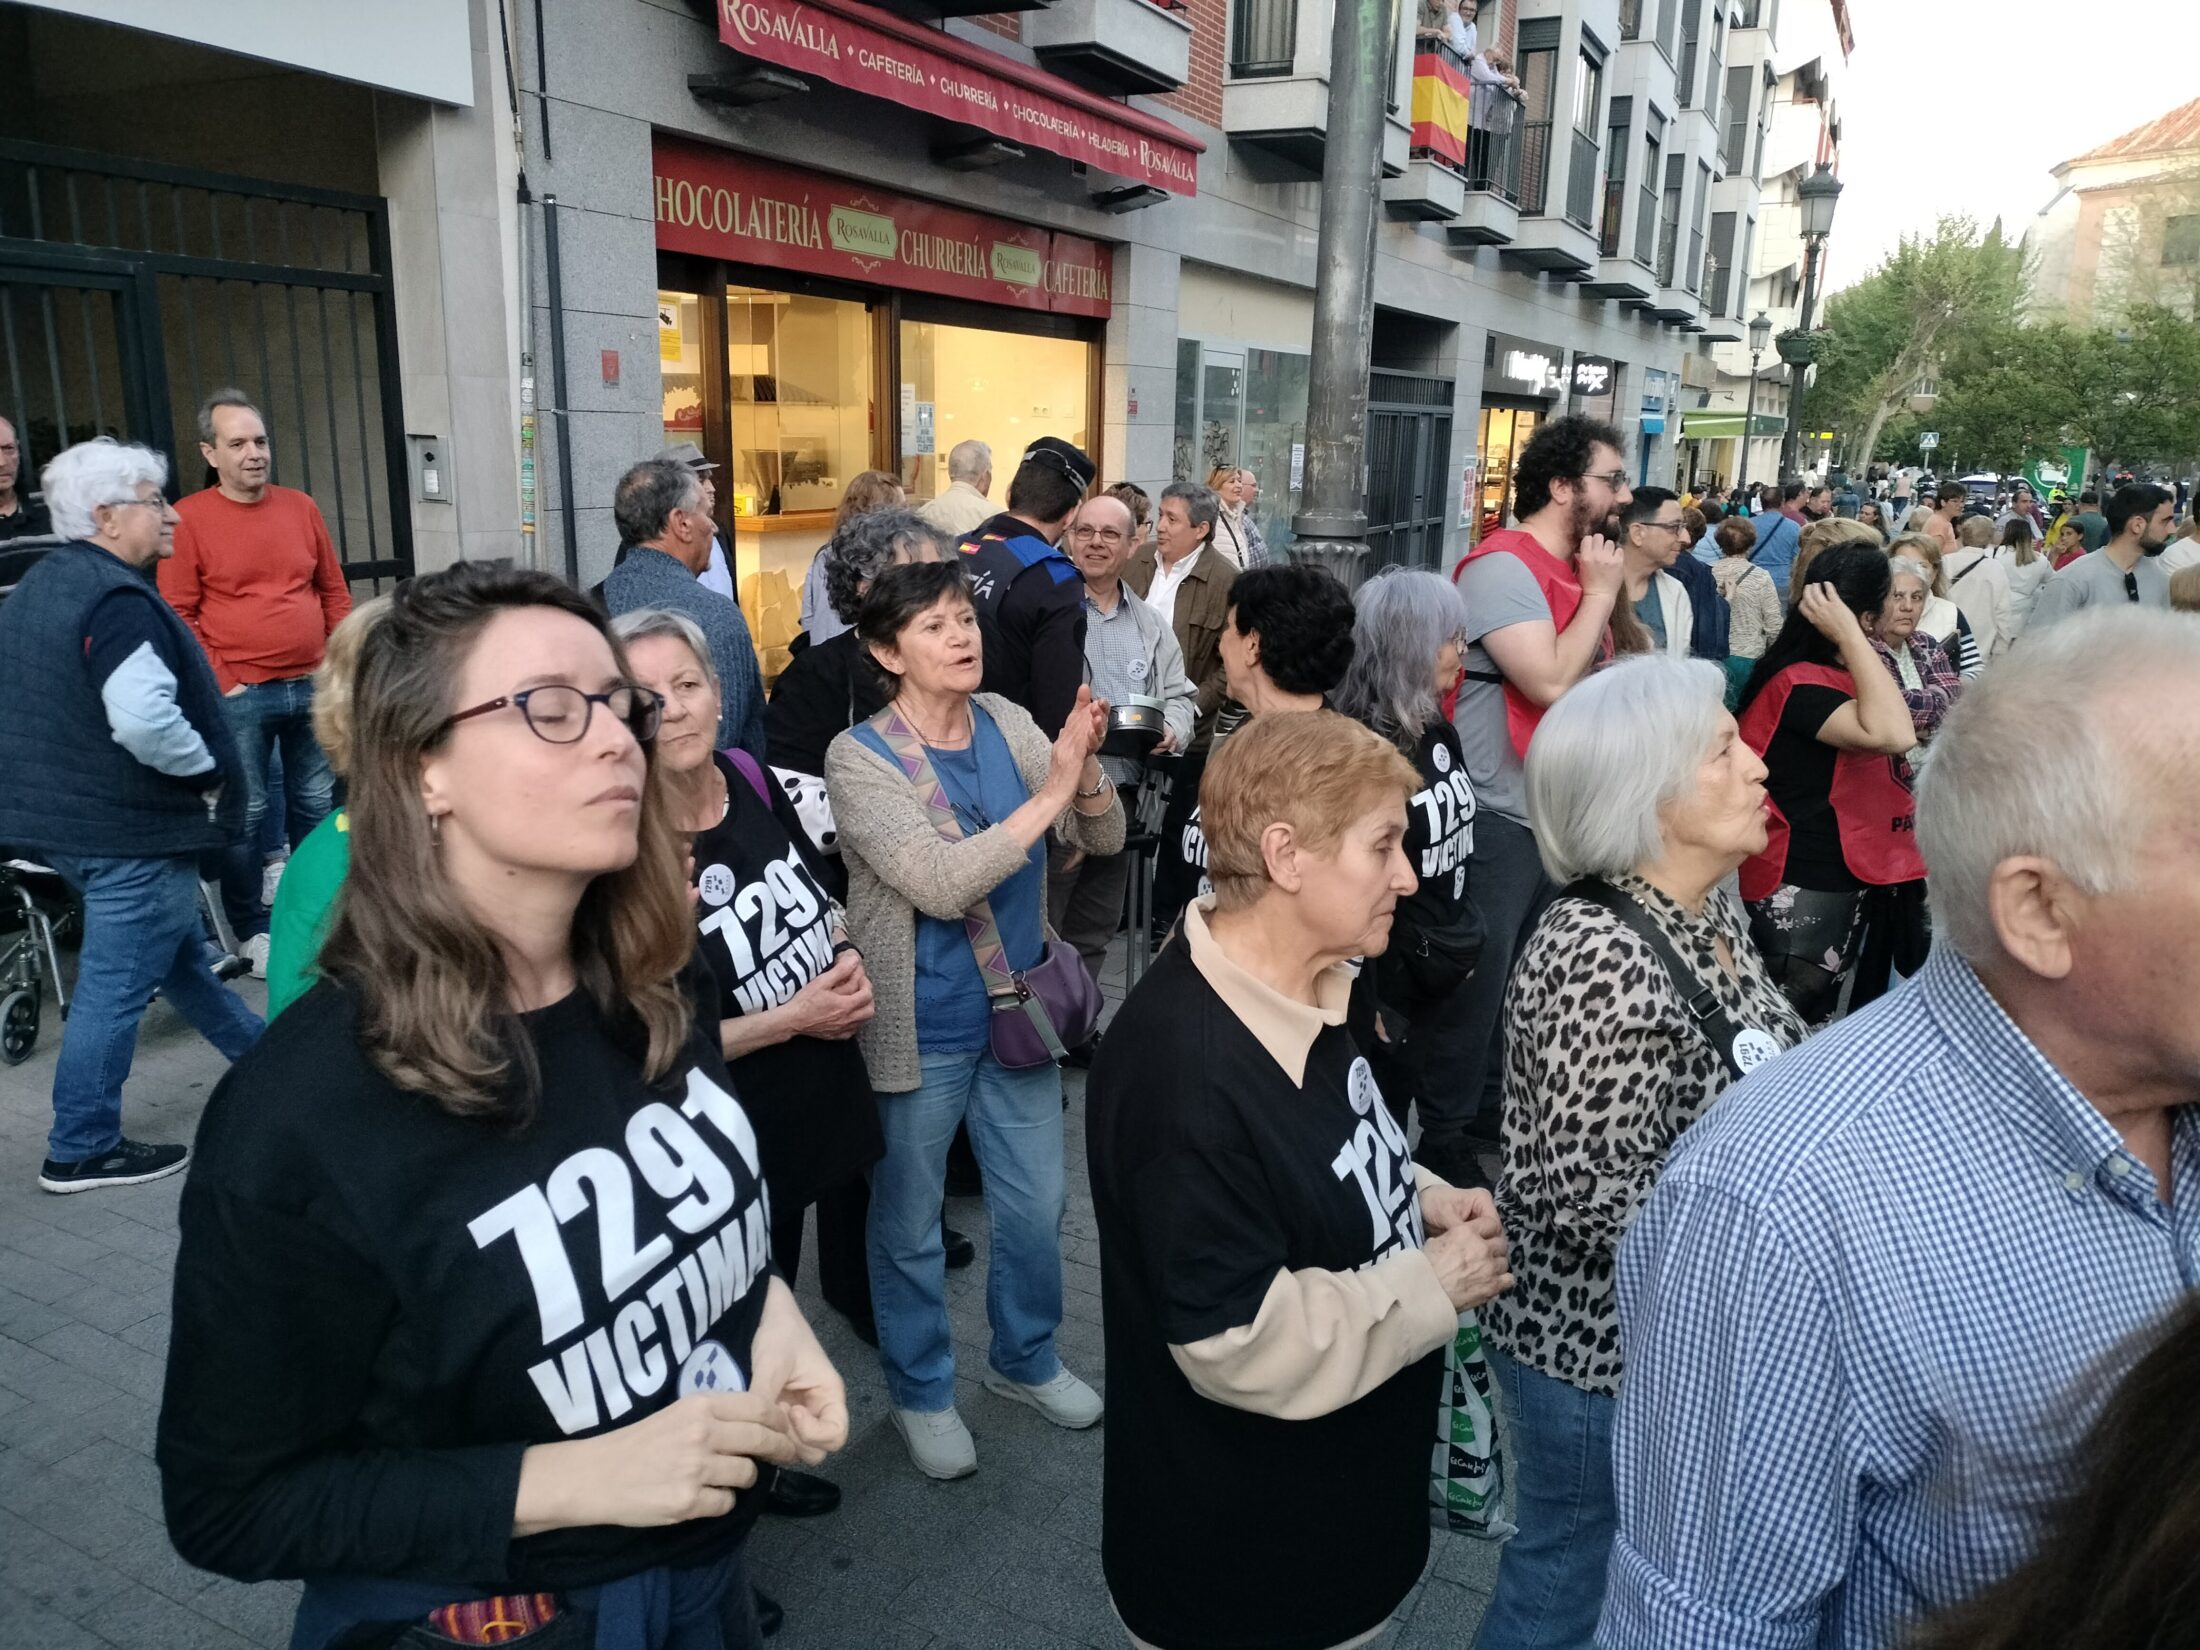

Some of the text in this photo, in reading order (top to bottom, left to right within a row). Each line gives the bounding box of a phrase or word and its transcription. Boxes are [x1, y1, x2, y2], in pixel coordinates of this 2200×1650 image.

[858, 49, 926, 87] CAFETERÍA
[940, 77, 999, 112] CHURRERÍA
[1012, 103, 1080, 140] CHOCOLATERÍA
[1088, 131, 1130, 159] HELADERÍA
[655, 176, 824, 250] HOCOLATERÍA
[900, 229, 987, 279] CHURRERÍA
[1043, 259, 1109, 300] CAFETERÍA
[732, 910, 834, 1016] VICTIM
[467, 1066, 760, 1346] 7291
[527, 1178, 772, 1434] VICTIMA
